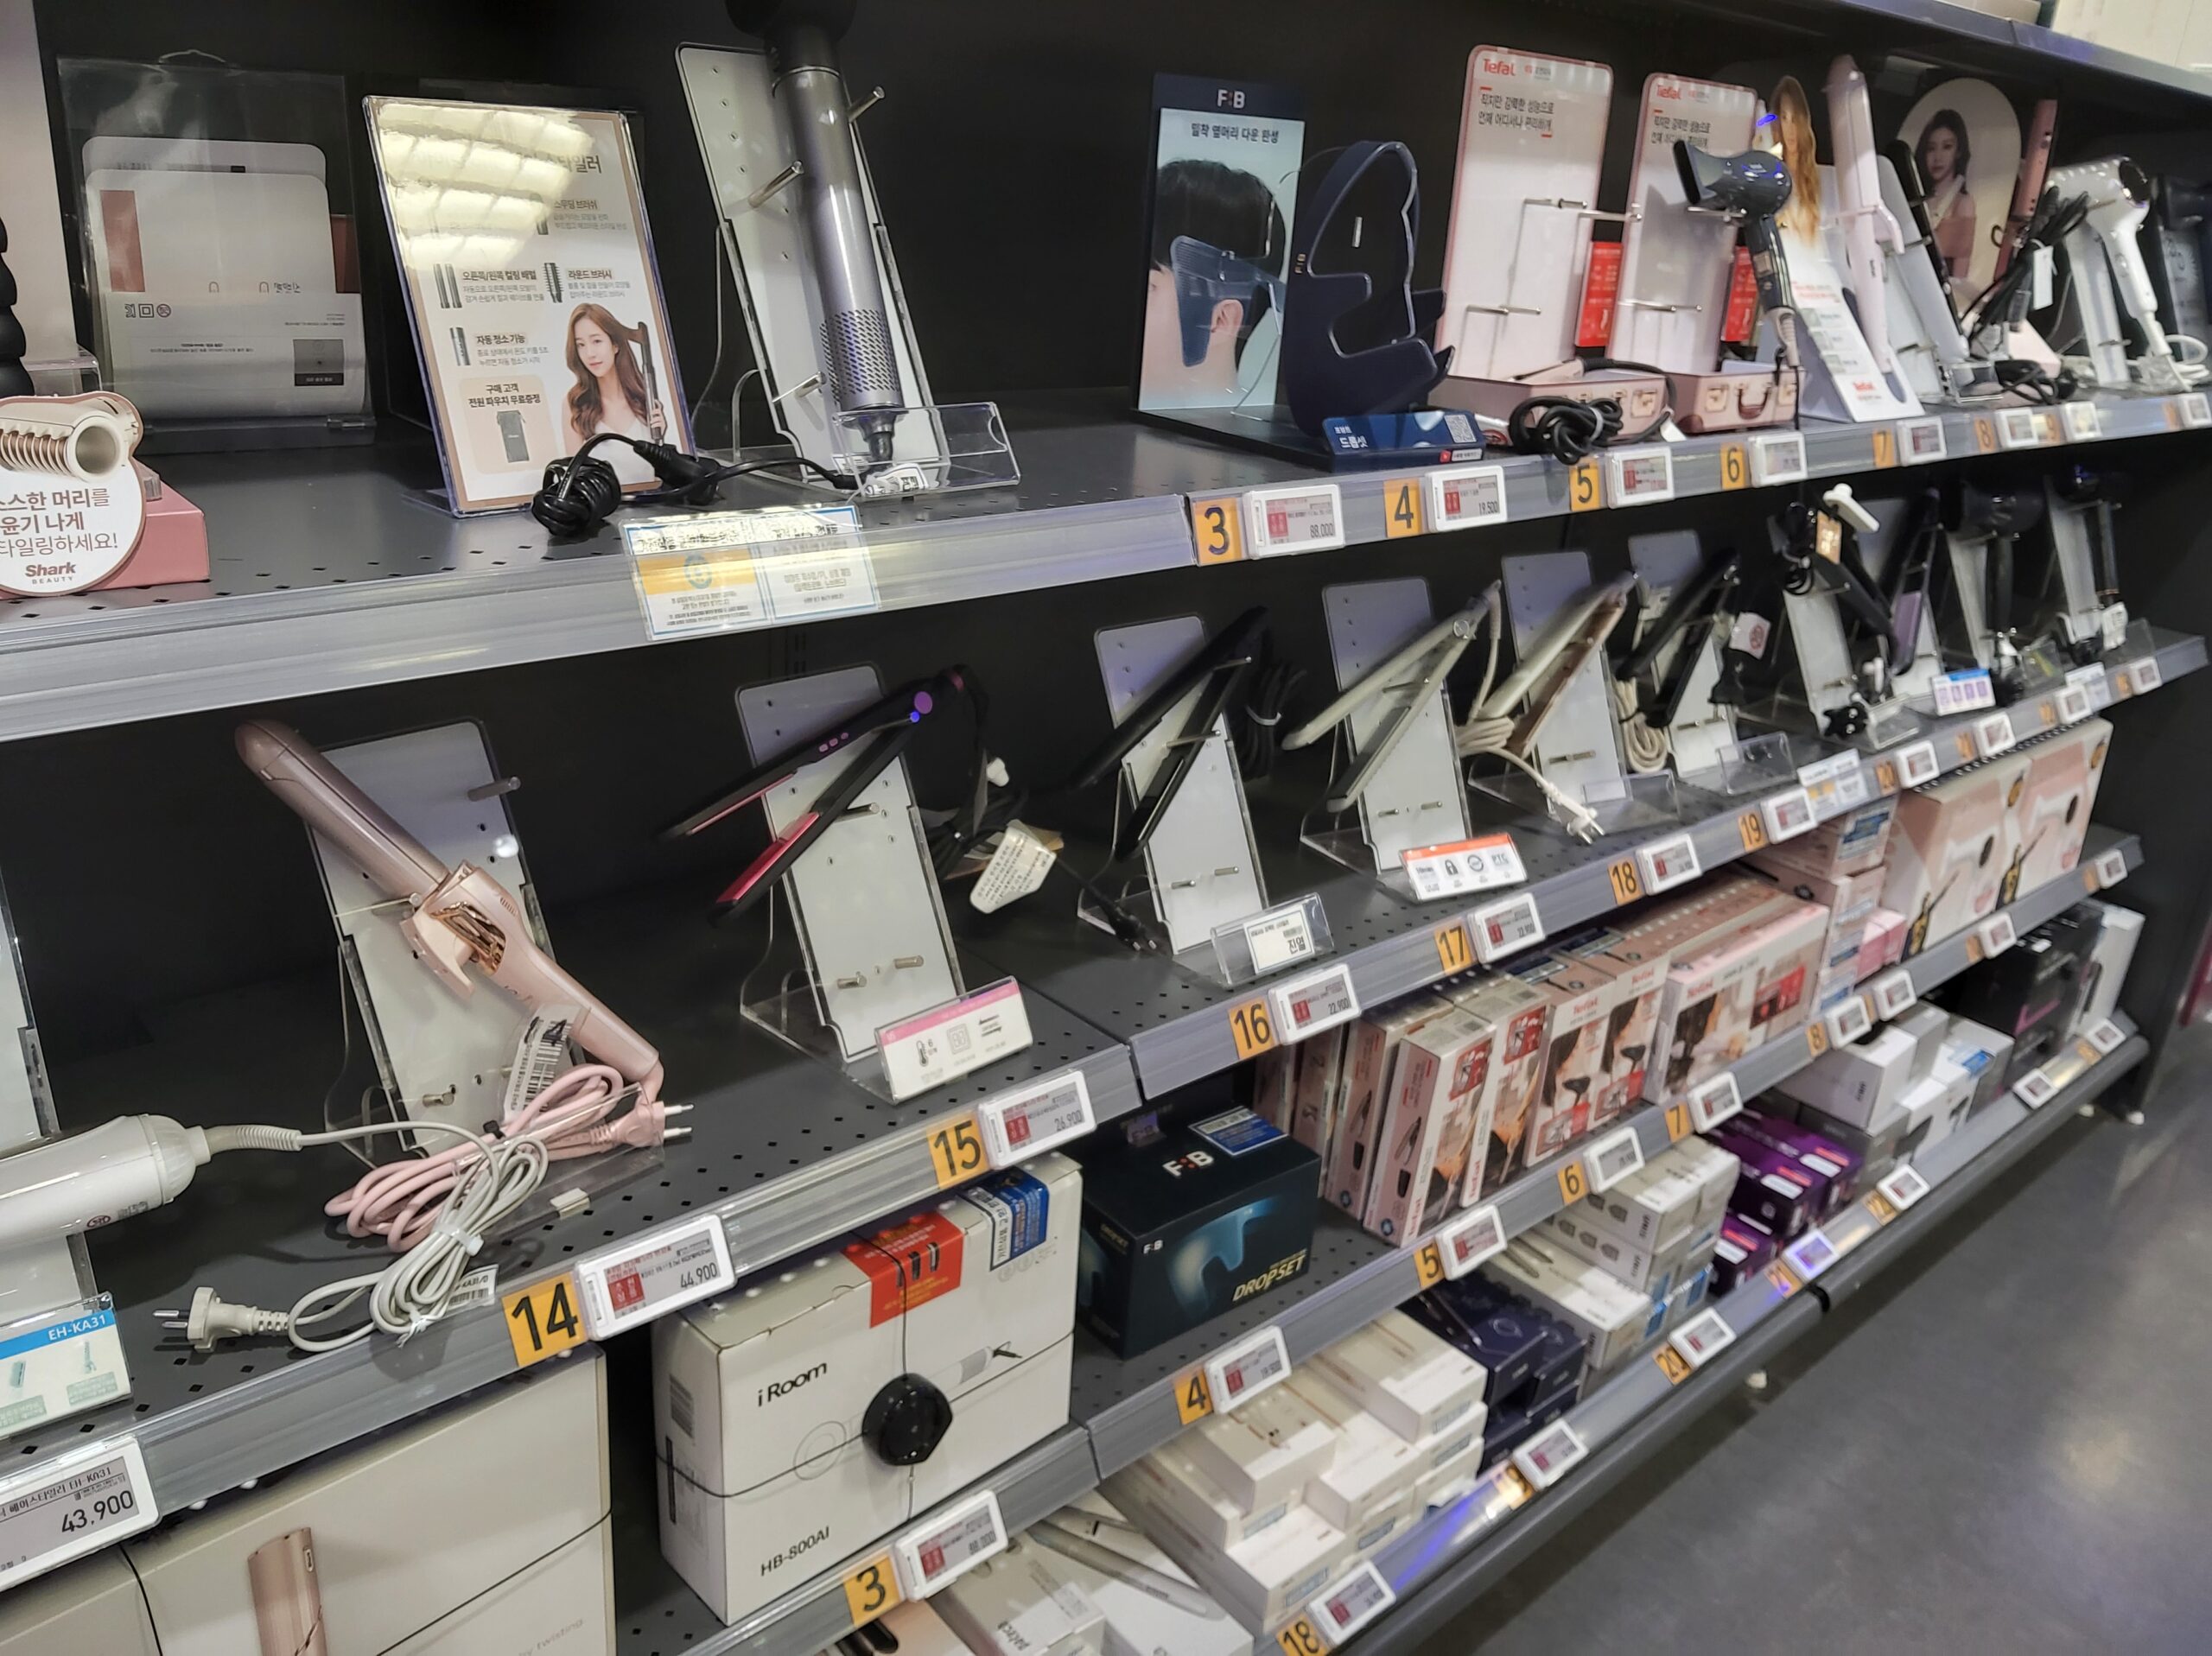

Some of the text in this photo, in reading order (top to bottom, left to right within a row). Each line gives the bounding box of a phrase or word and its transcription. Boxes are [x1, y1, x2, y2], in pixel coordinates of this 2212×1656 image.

[1484, 59, 1516, 76] Tefal
[1242, 128, 1259, 142] 다운
[568, 270, 590, 279] 라운드
[476, 333, 526, 346] 자동 청소 기능
[486, 397, 510, 406] 파우치
[503, 384, 519, 393] 고객
[1728, 447, 1740, 483] 6
[52, 488, 110, 510] 머리를
[1577, 464, 1593, 504] 5
[45, 511, 85, 533] 나게
[1395, 485, 1414, 529] 4
[1205, 505, 1230, 556] 3
[25, 562, 77, 578] Shark
[1741, 813, 1761, 846] 19
[1612, 861, 1637, 898] 18
[1439, 925, 1465, 967] 17
[1234, 1003, 1270, 1050] 16
[933, 1120, 982, 1177] 15
[1564, 1164, 1580, 1196] 6
[1232, 1254, 1306, 1302] DROPSET
[1424, 1243, 1440, 1278] 5
[48, 1314, 106, 1341] EH-KA31
[511, 1281, 578, 1352] 14
[767, 1362, 828, 1403] Room
[1187, 1375, 1206, 1410] 4
[760, 1525, 830, 1577] HB-800AI
[856, 1565, 887, 1611] 3
[1283, 1621, 1320, 1656] 18
